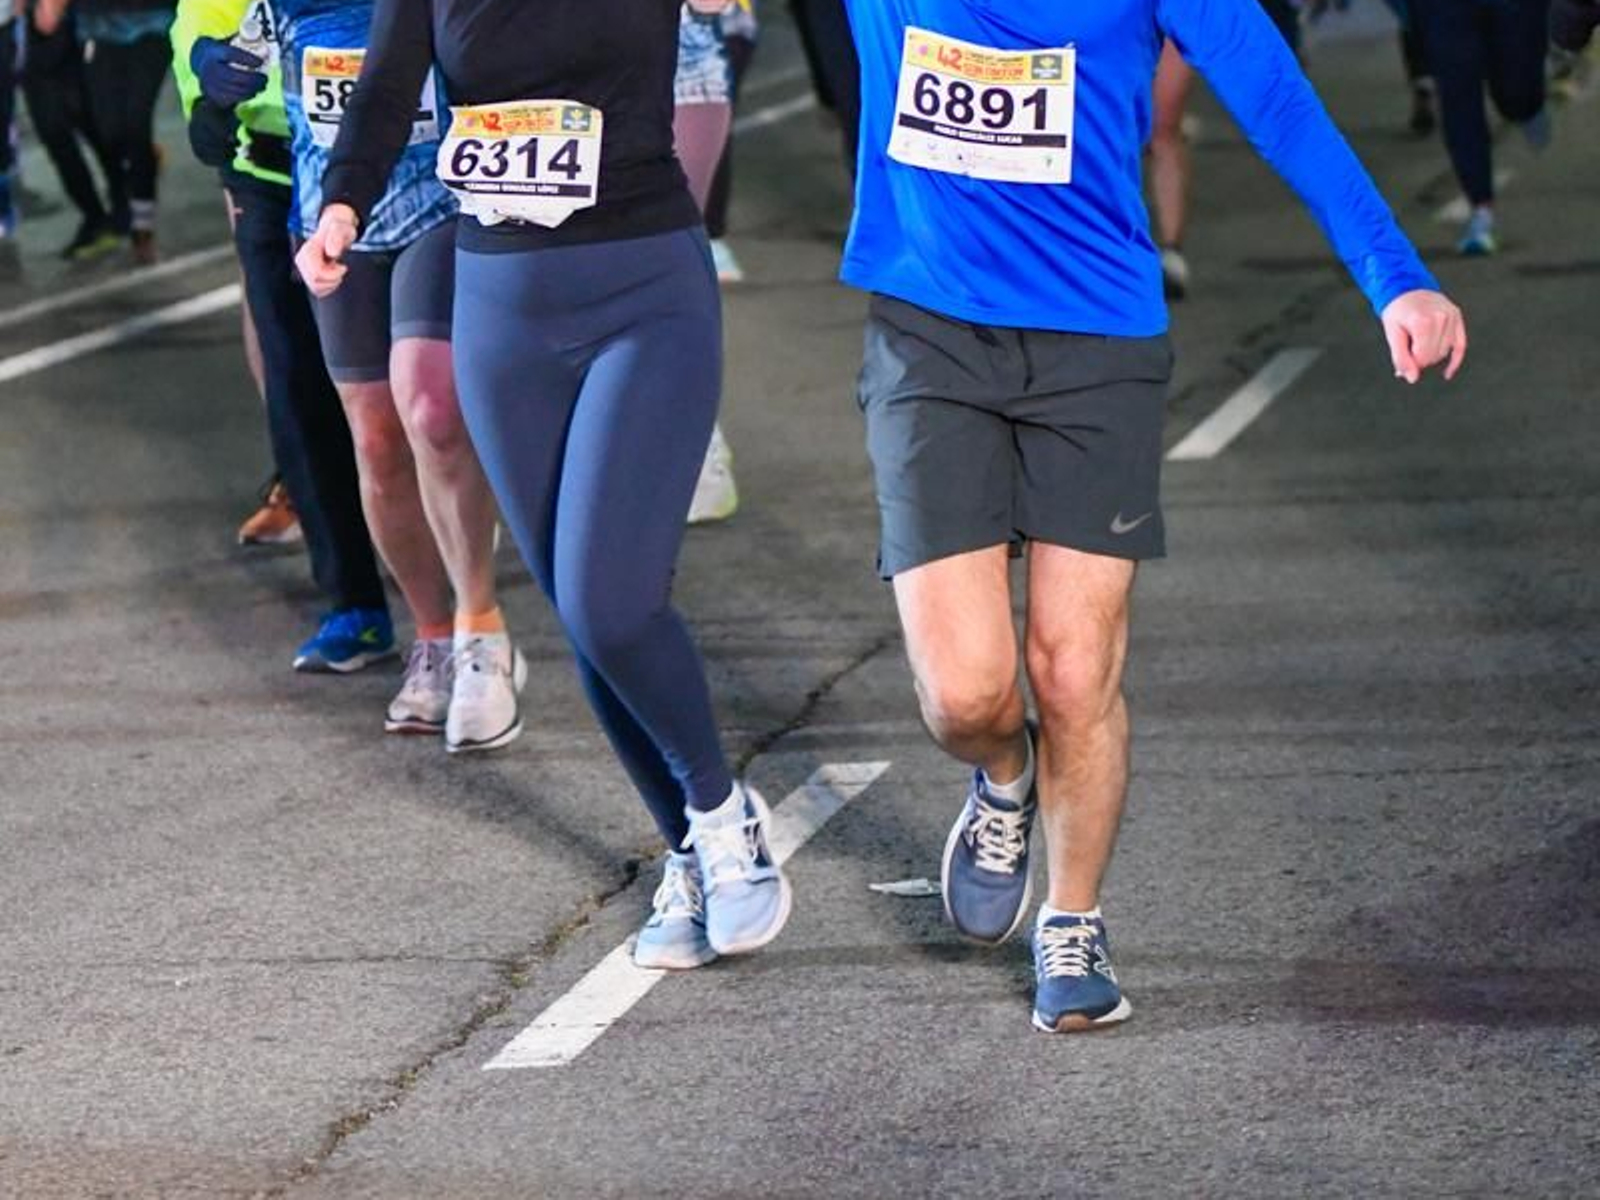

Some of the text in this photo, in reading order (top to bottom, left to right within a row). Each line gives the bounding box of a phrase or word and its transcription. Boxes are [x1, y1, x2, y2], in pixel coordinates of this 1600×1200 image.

[937, 45, 963, 71] 42
[913, 72, 1048, 131] 6891
[450, 136, 582, 181] 6314
